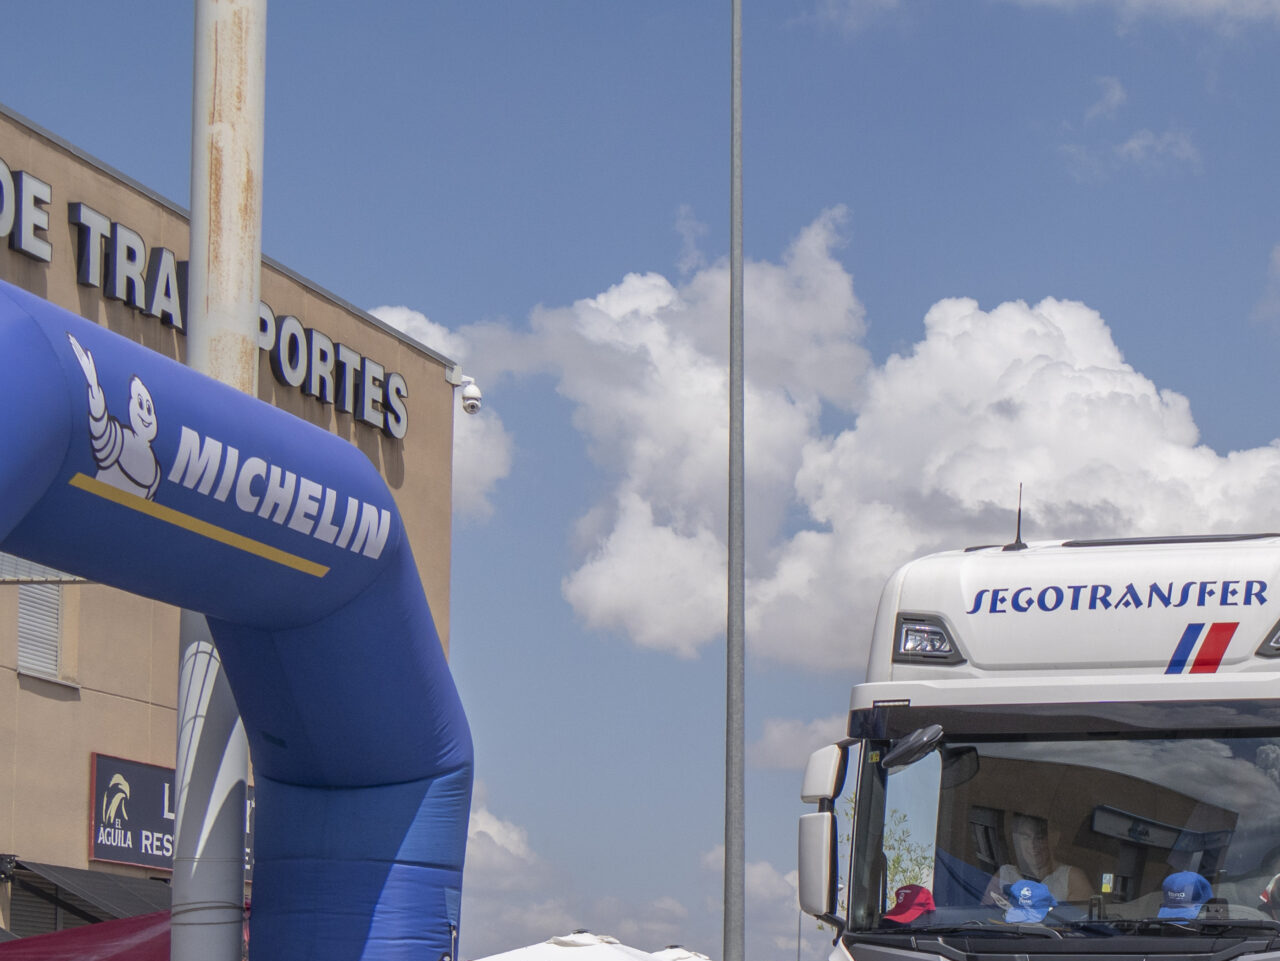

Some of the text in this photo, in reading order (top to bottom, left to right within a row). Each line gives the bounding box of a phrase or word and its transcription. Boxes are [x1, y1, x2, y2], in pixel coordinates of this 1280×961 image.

[68, 202, 408, 439] TRAPORTES
[168, 426, 391, 559] MICHELIN
[966, 580, 1268, 614] SEGOTRANSFER
